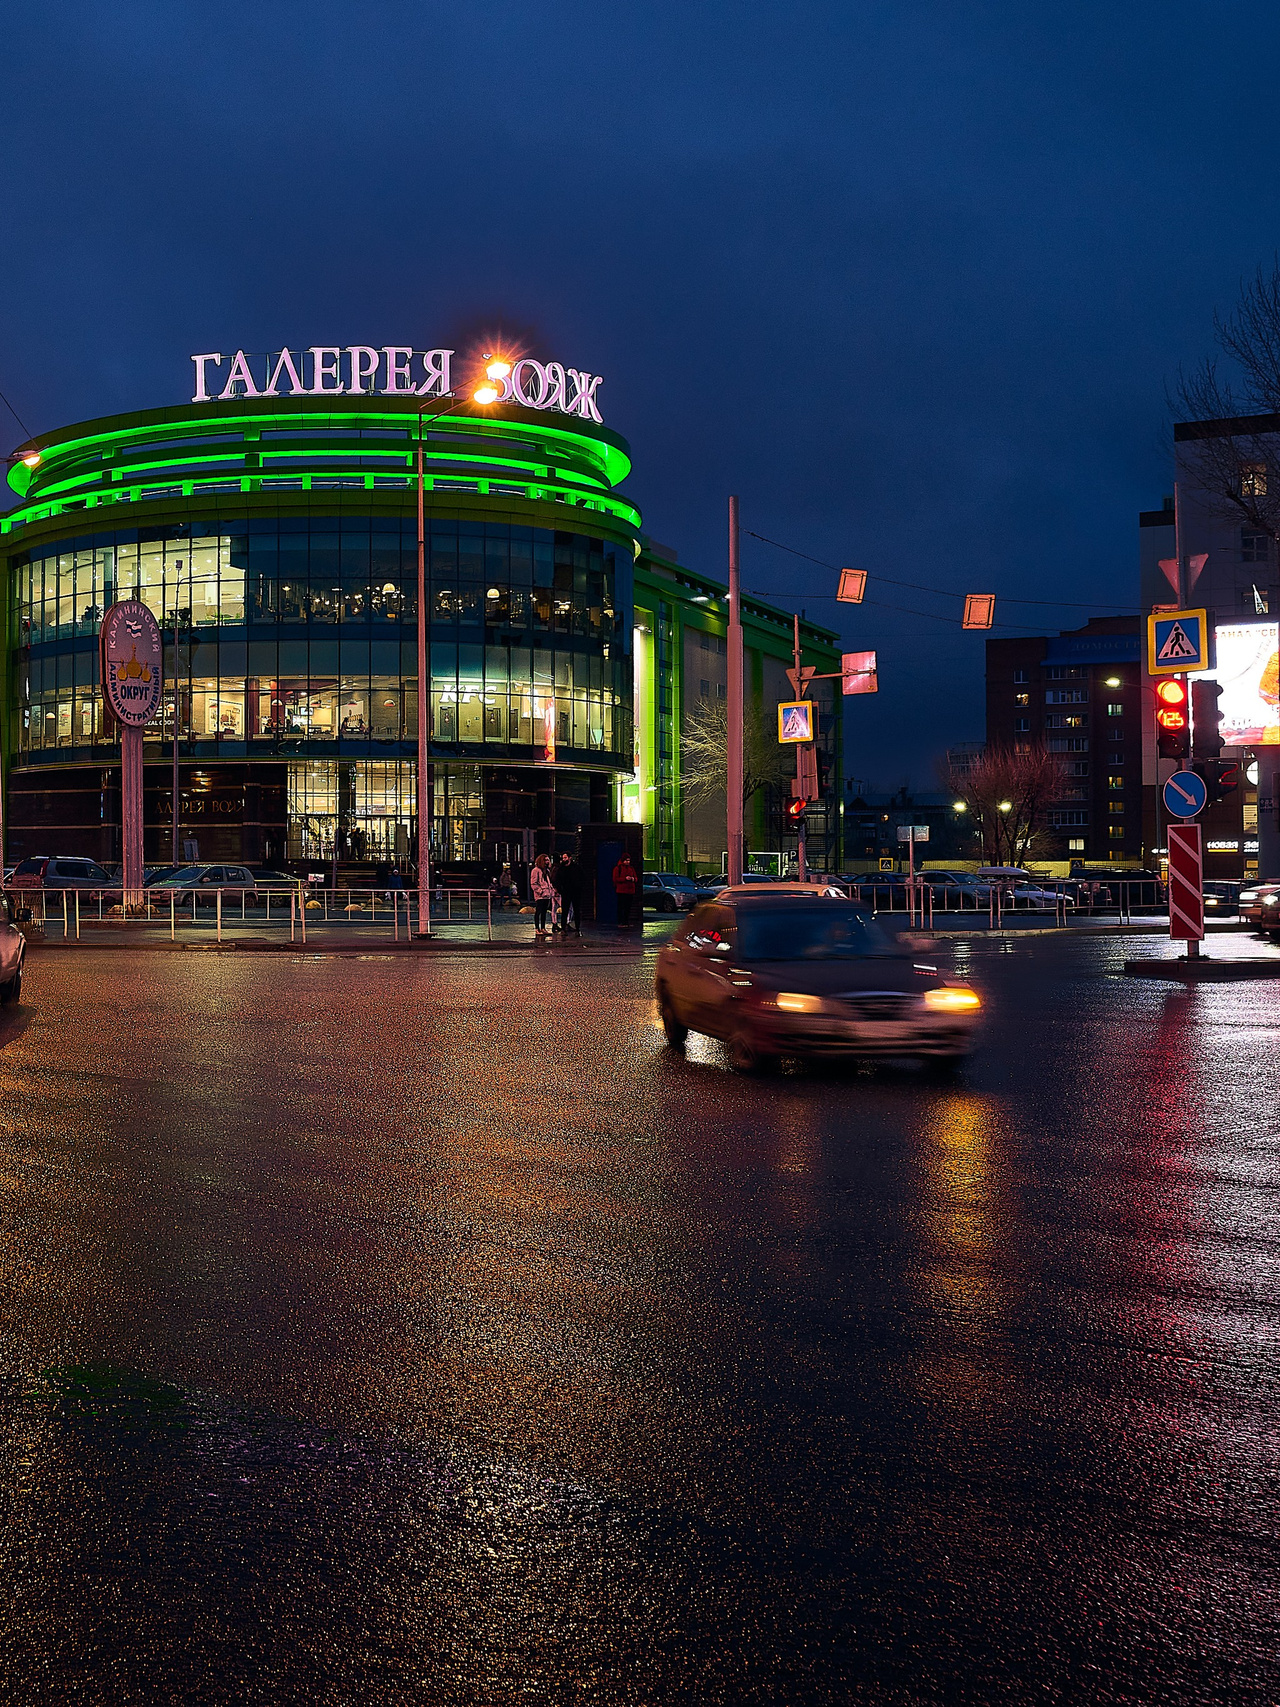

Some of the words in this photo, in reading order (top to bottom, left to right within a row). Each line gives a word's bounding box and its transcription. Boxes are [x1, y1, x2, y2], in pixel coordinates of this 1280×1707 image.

[191, 346, 454, 403] ГАЛЕРЕЯ
[109, 604, 160, 653] КАЛИНИНСКИЙ
[109, 663, 160, 722] АДМИНИСТРАТИВНЫЙ
[120, 685, 150, 701] ОКРУГ
[439, 685, 497, 704] KFC
